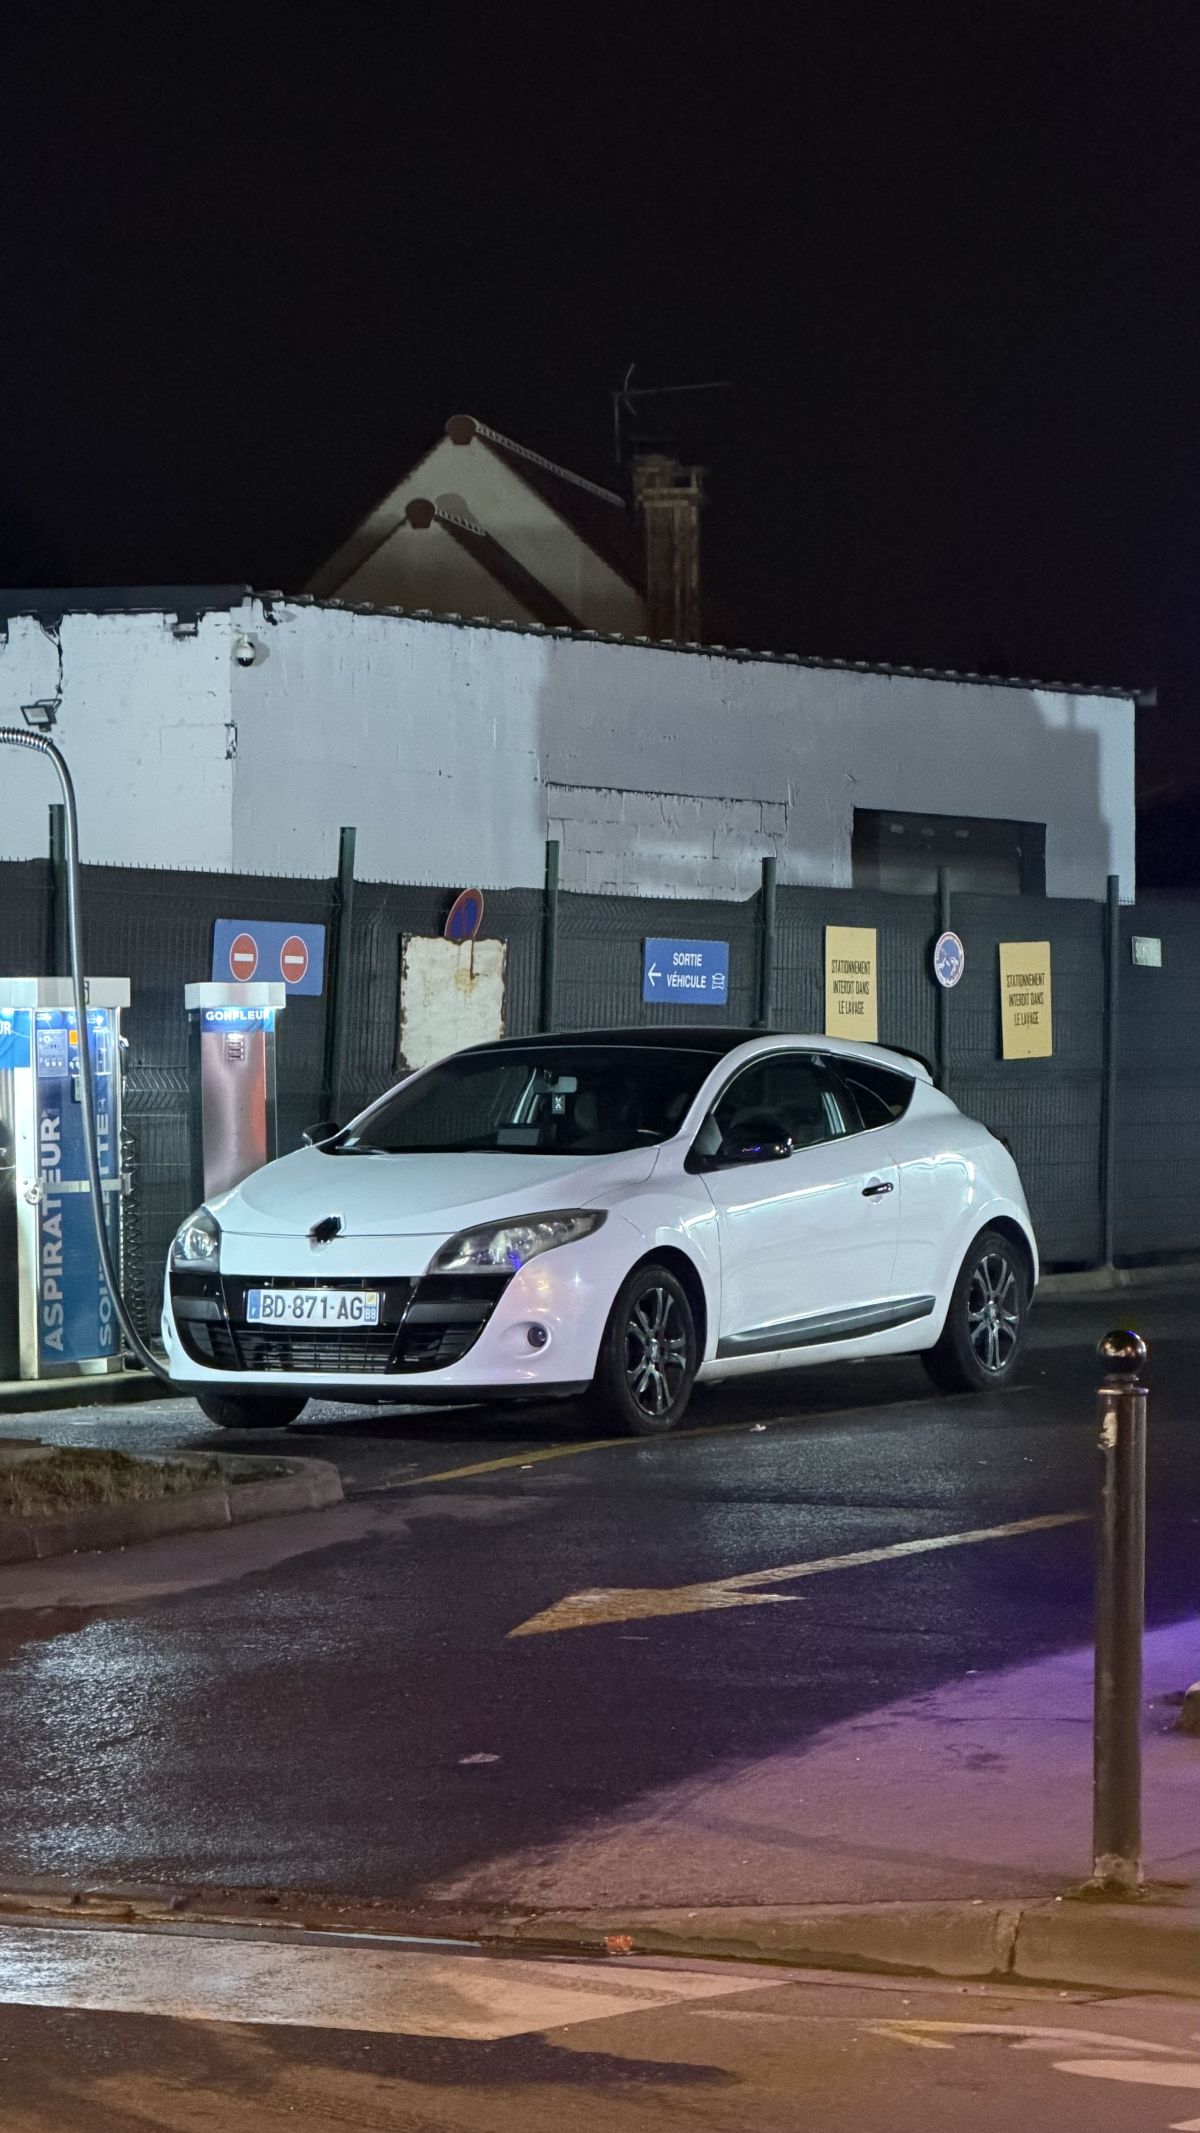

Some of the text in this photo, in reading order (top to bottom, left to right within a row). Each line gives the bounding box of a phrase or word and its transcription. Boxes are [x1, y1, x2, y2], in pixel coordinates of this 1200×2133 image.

[672, 952, 703, 967] SORTIE
[831, 959, 871, 974] STATIONNEMENT
[666, 971, 707, 989] VÉHICULE
[833, 980, 869, 995] INTERDIT DANS
[1006, 972, 1045, 988] STATIONNEMENT
[838, 1000, 864, 1015] LE LAVAGE
[205, 1010, 270, 1021] GONFLEUR
[40, 1115, 63, 1352] ASPIRATEUR
